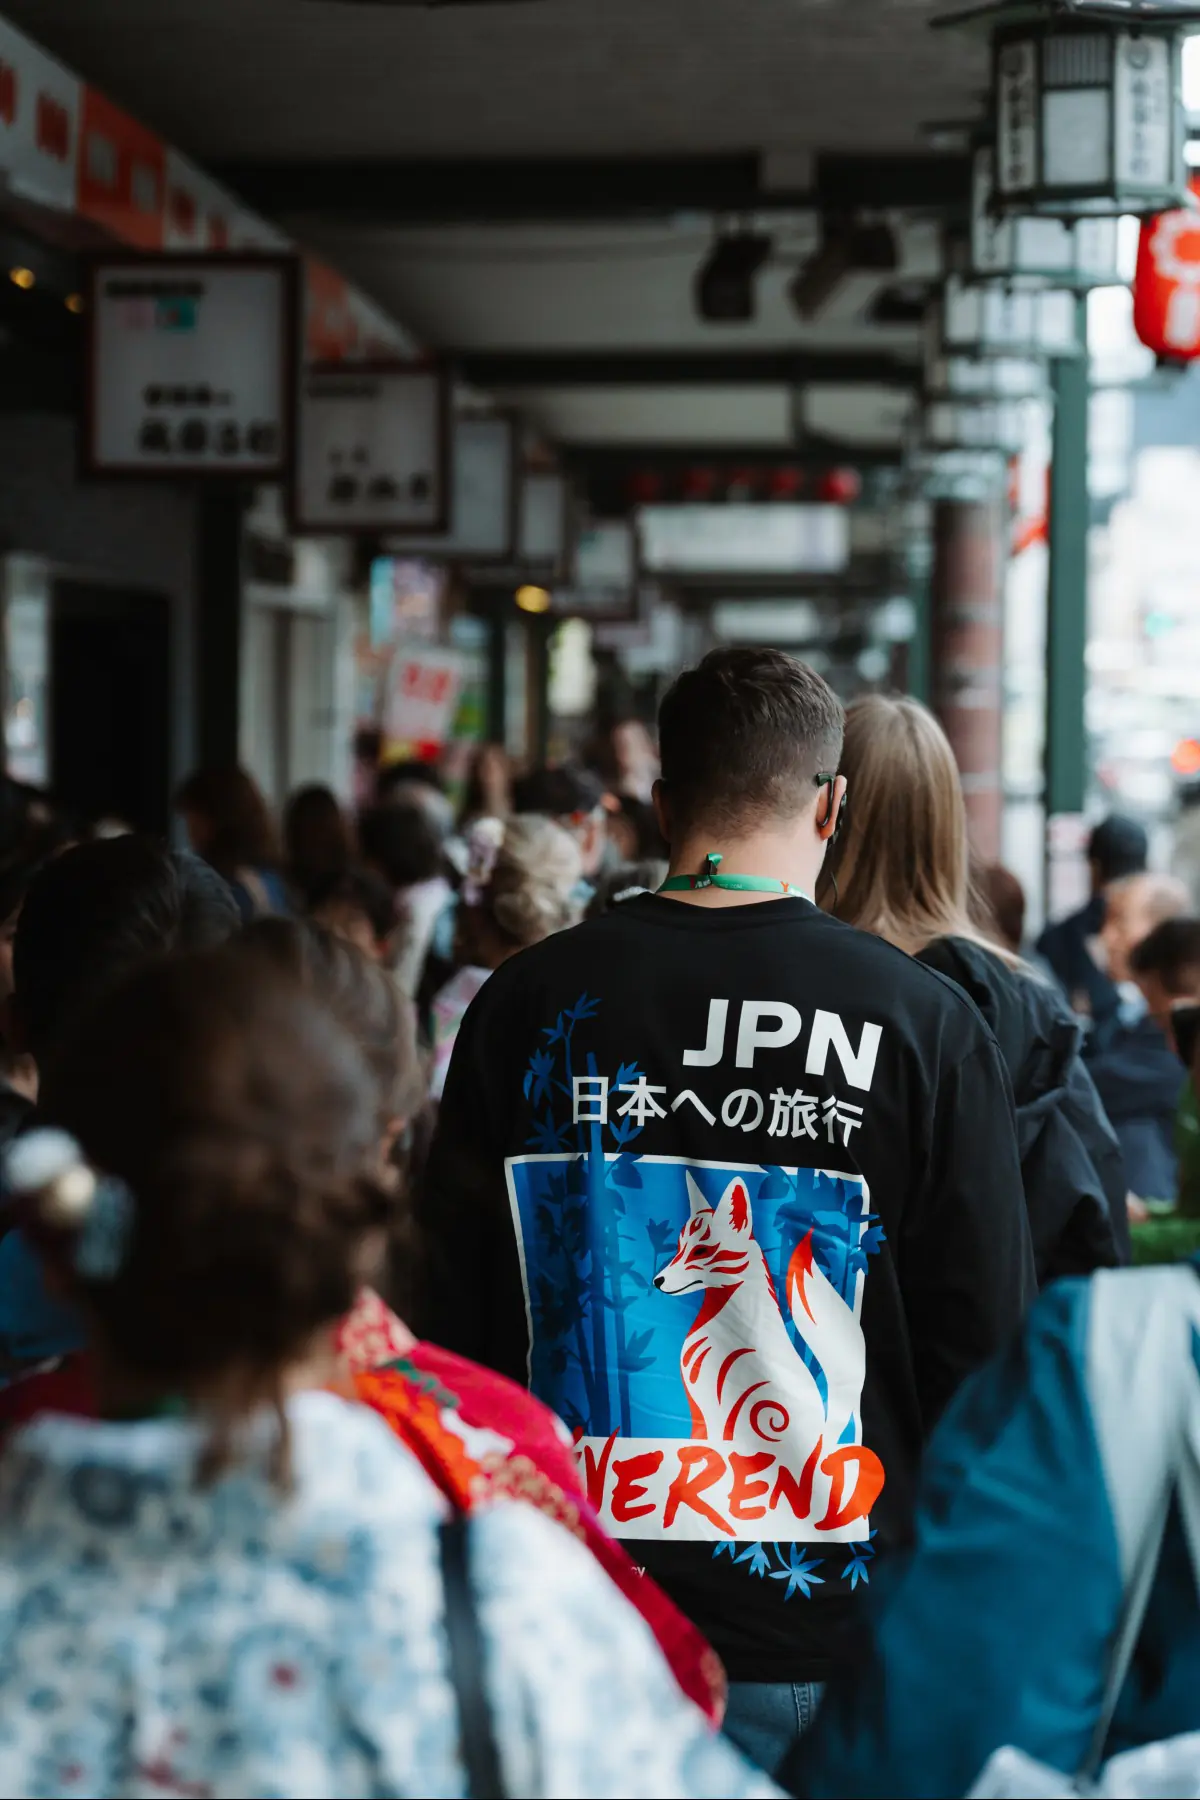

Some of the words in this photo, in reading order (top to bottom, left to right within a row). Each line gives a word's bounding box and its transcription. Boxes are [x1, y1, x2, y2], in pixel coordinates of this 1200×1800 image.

[682, 998, 883, 1092] JPN
[572, 1075, 864, 1148] 日本への旅行
[572, 1426, 885, 1537] VEREND
